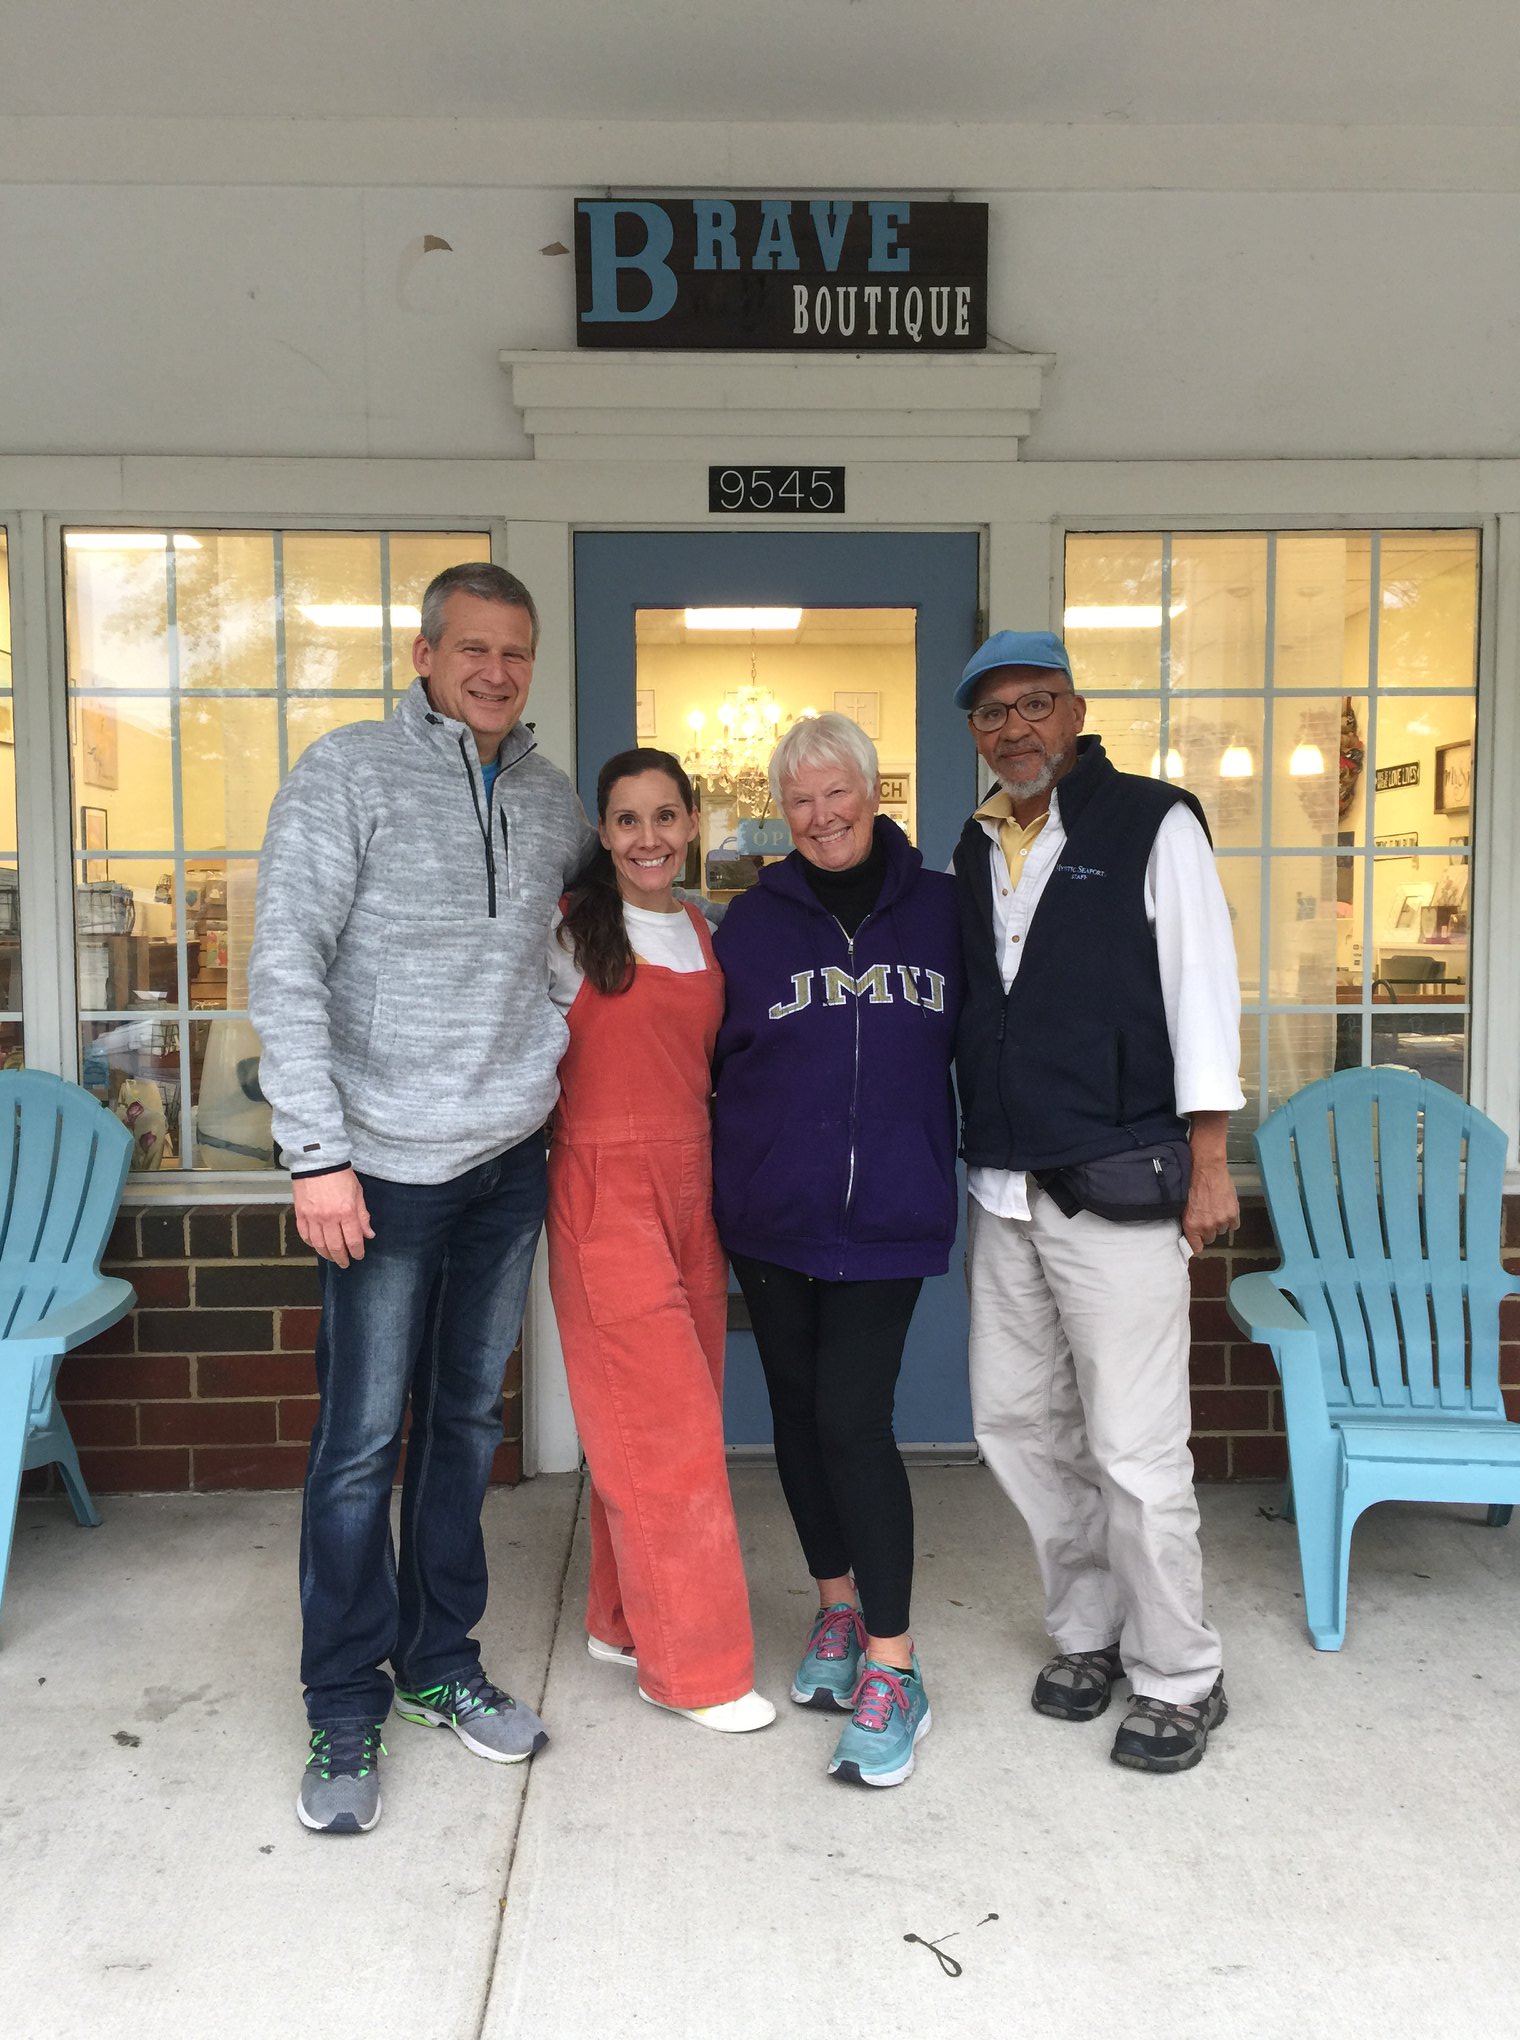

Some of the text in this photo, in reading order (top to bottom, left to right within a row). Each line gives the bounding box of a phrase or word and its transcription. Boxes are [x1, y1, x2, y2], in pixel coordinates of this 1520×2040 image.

[578, 200, 911, 323] BRAVE
[792, 284, 971, 342] BOUTIQUE
[719, 469, 834, 509] 9545
[768, 964, 946, 1020] JMU
